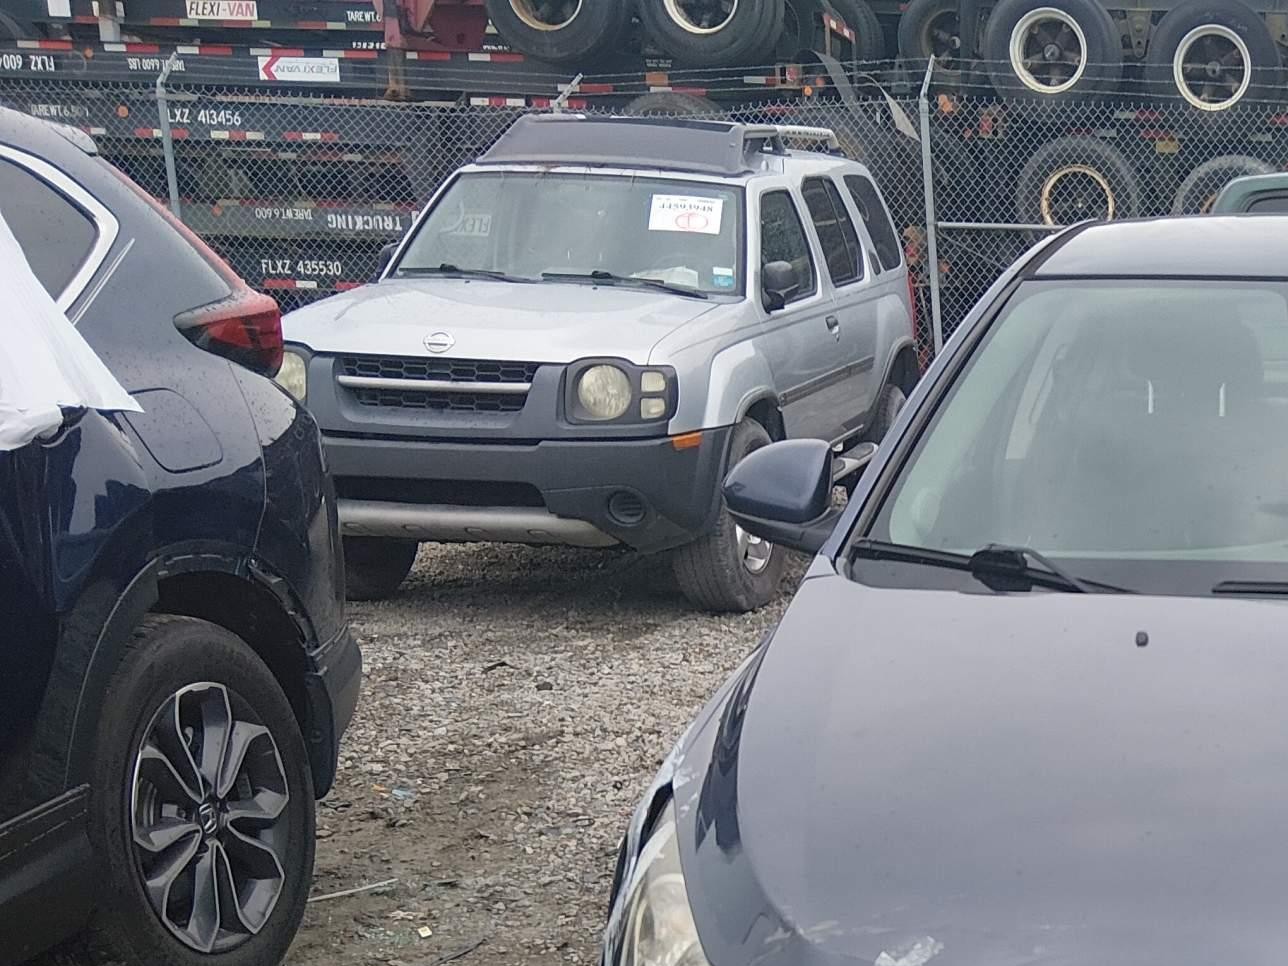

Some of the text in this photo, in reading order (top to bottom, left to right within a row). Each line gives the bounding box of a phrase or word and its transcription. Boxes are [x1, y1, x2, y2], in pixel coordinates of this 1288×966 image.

[188, 1, 256, 17] FLEXI-VAN
[0, 54, 55, 72] FLXZ 600
[166, 108, 242, 126] LXZ 413456
[327, 213, 403, 231] TRUCKING
[261, 259, 342, 275] FLXZ 435530
